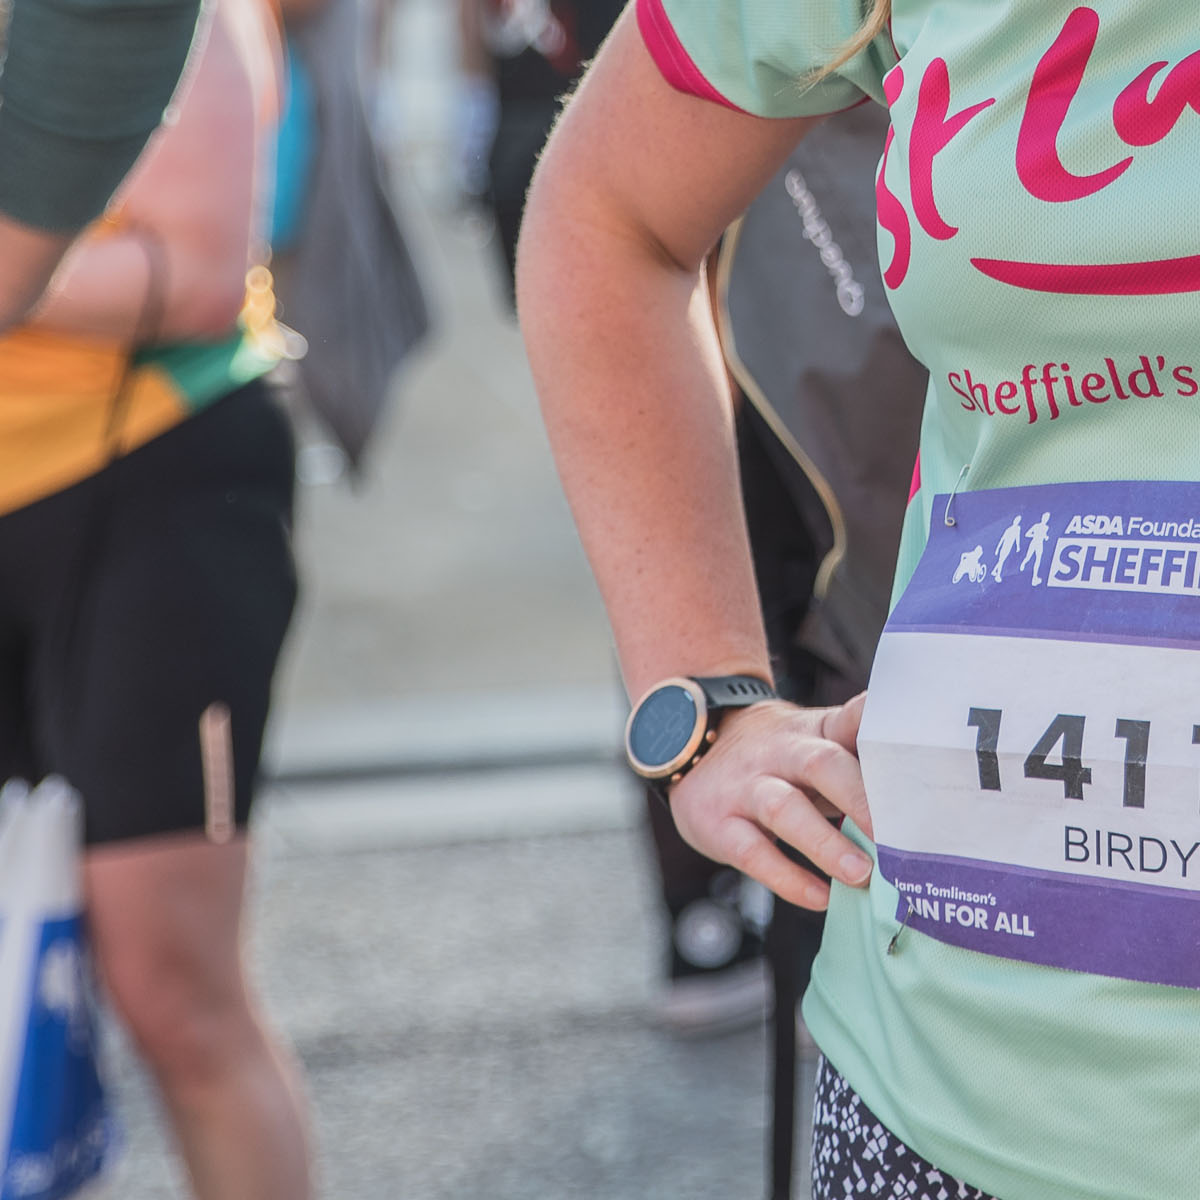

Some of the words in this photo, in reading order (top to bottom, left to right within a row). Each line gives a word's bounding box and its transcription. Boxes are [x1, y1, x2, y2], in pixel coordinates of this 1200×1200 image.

[947, 355, 1199, 425] Sheffield's
[1064, 515, 1124, 536] ASDA
[1063, 825, 1200, 878] BIRDY
[925, 882, 997, 907] Tomlinson's
[944, 902, 989, 930] FOR
[993, 911, 1035, 937] ALL
